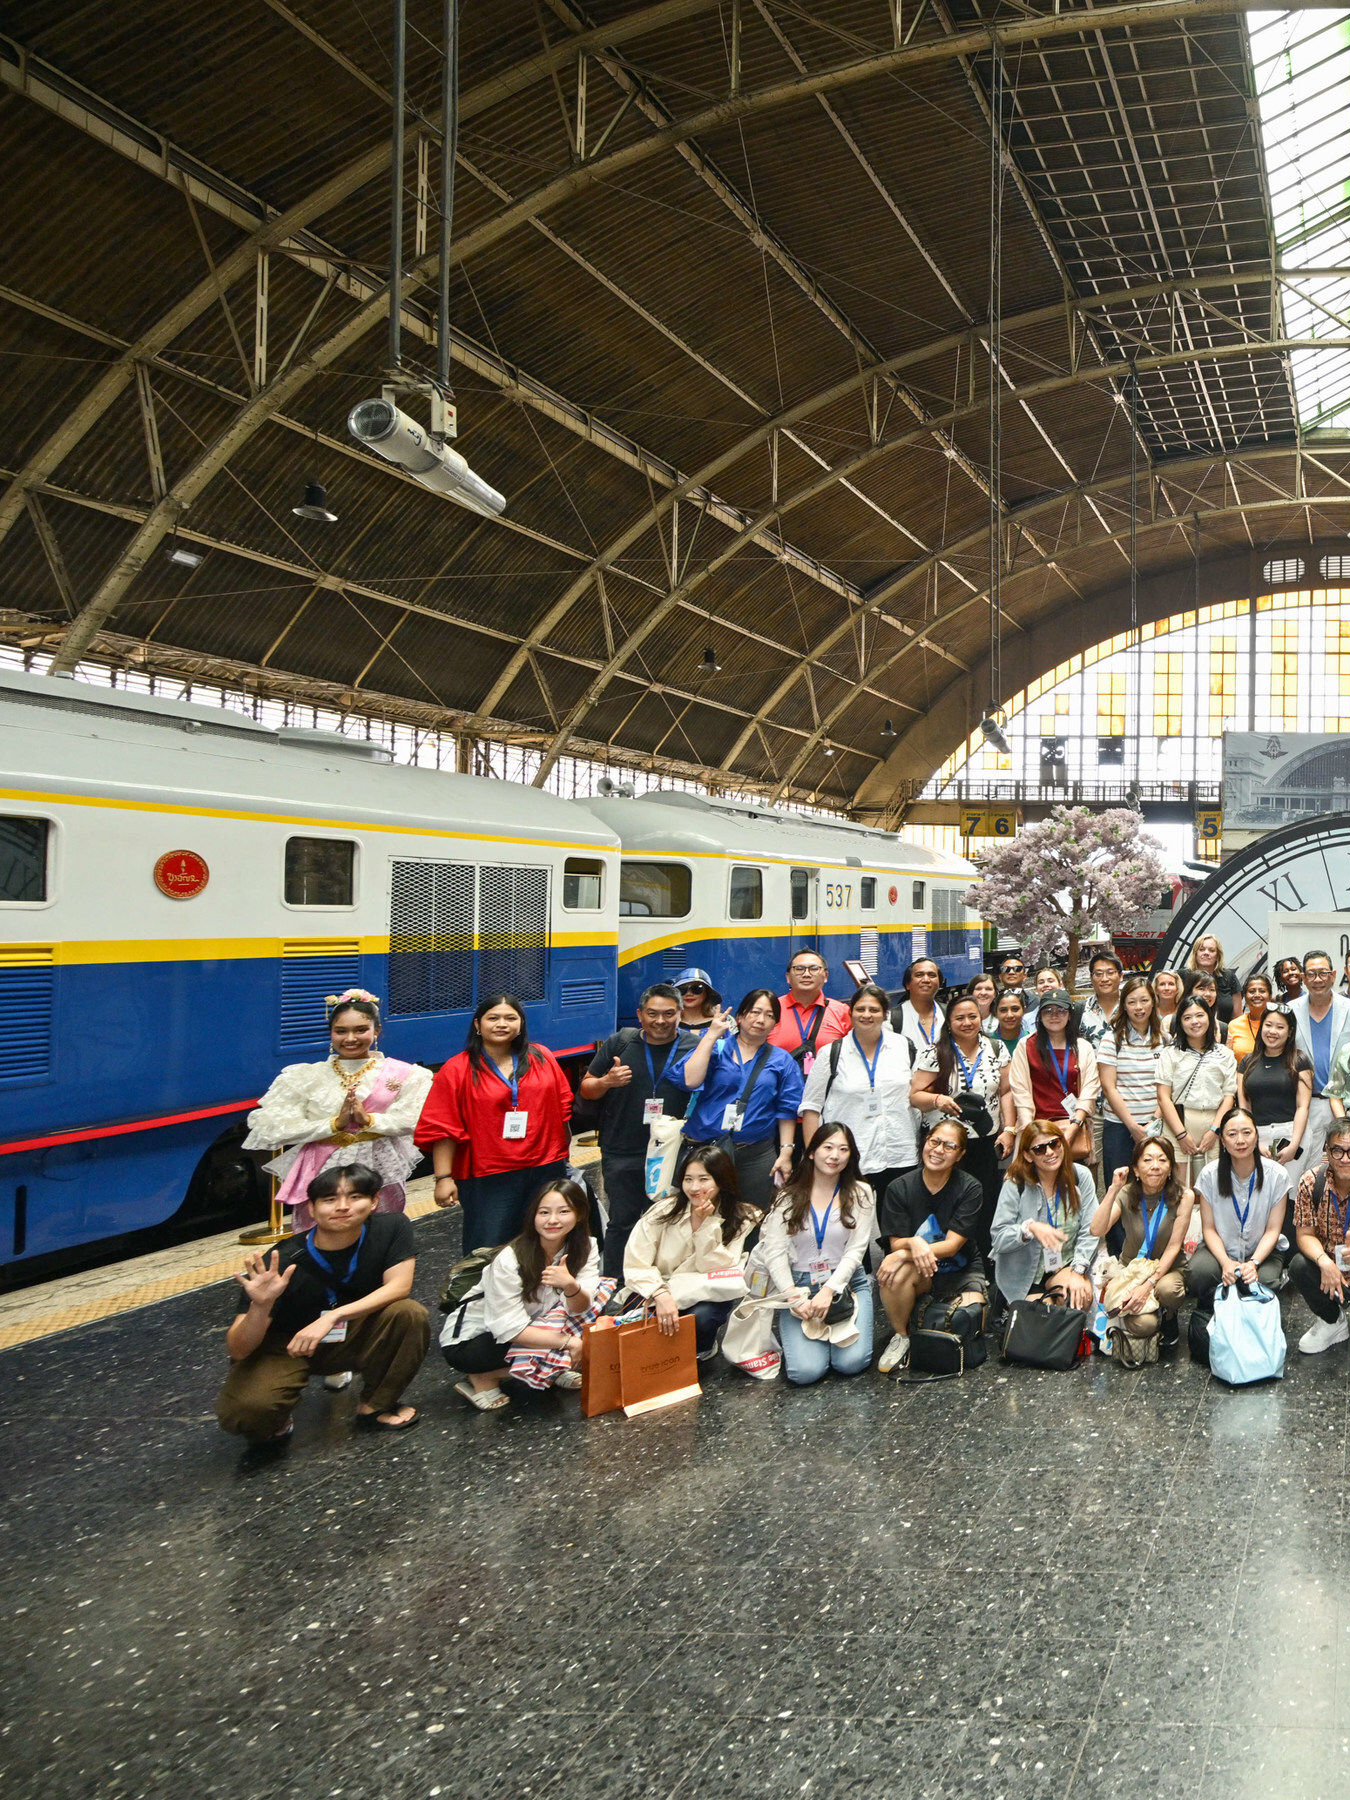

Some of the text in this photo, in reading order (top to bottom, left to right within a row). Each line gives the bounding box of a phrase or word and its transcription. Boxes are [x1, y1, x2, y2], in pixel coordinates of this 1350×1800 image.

[967, 817, 981, 835] 7
[995, 818, 1009, 835] 6
[1203, 818, 1218, 837] 5
[826, 884, 853, 909] 537
[1256, 871, 1308, 912] XI
